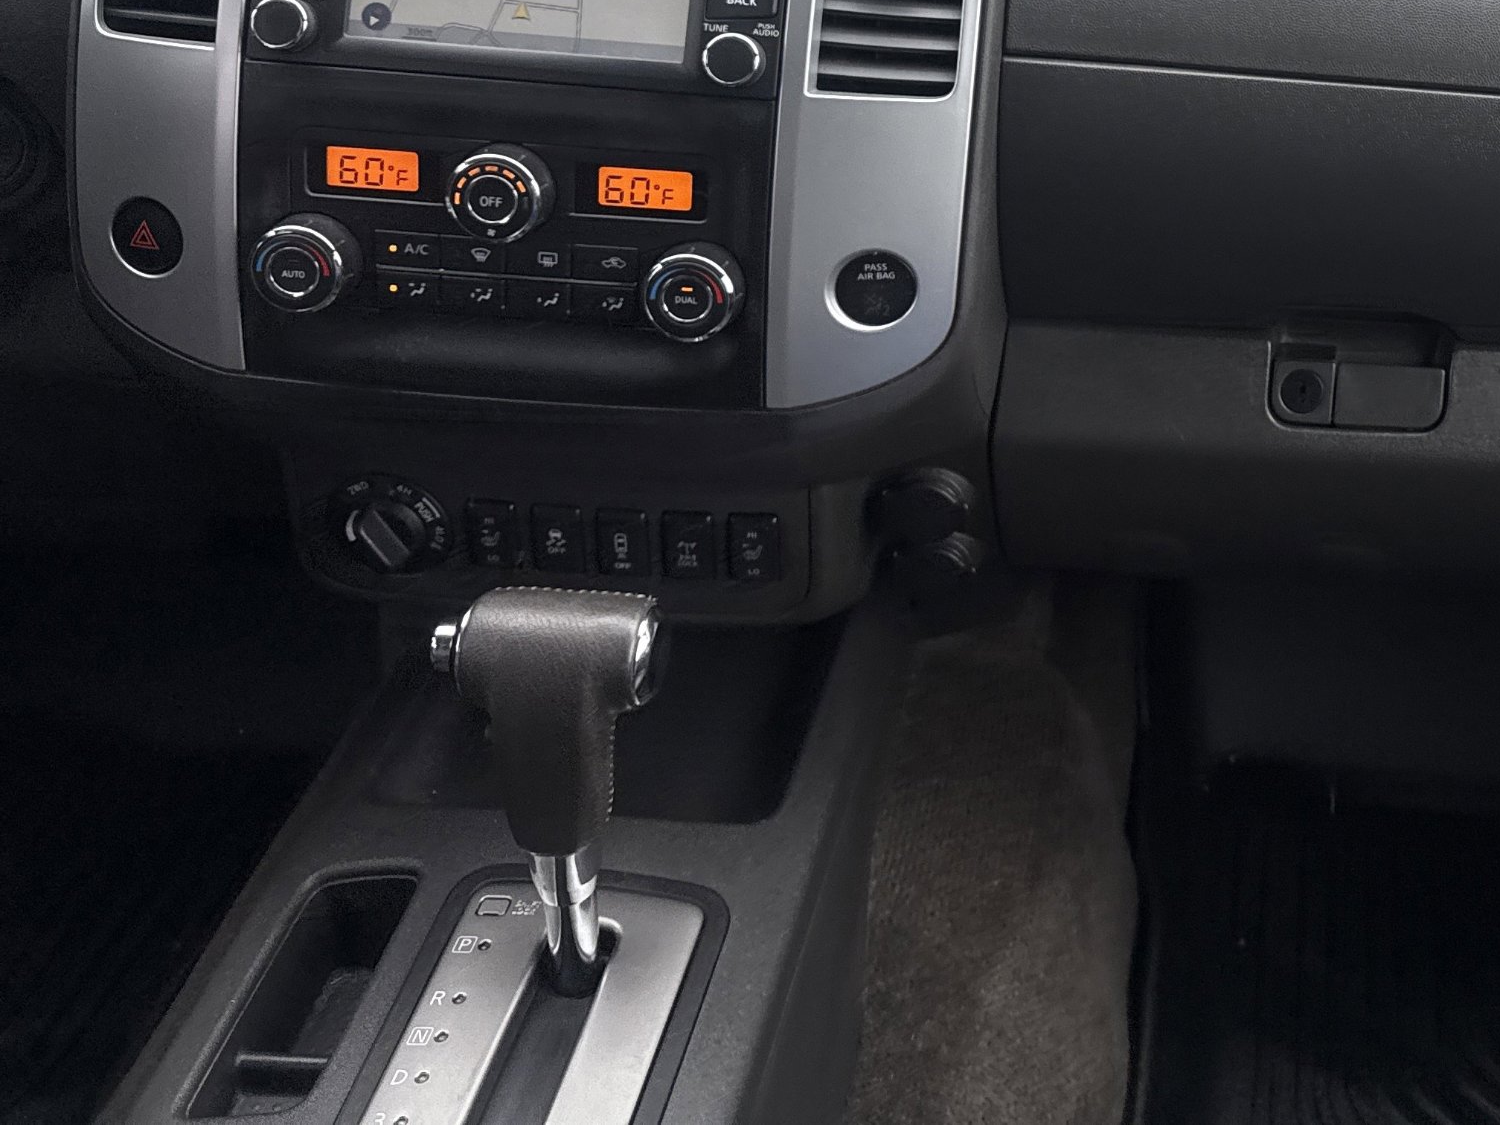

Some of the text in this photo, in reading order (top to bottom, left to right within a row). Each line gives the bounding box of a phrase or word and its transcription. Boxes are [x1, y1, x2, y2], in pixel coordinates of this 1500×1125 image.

[703, 23, 729, 33] TUNE
[753, 28, 779, 37] AUDIO
[479, 196, 503, 208] OFF
[404, 243, 430, 256] A/C
[864, 263, 888, 272] PASS
[281, 269, 306, 279] AUTO
[674, 294, 698, 305] DUAL
[458, 938, 473, 951] P
[430, 991, 446, 1006] R
[411, 1029, 431, 1043] N
[390, 1069, 409, 1085] D
